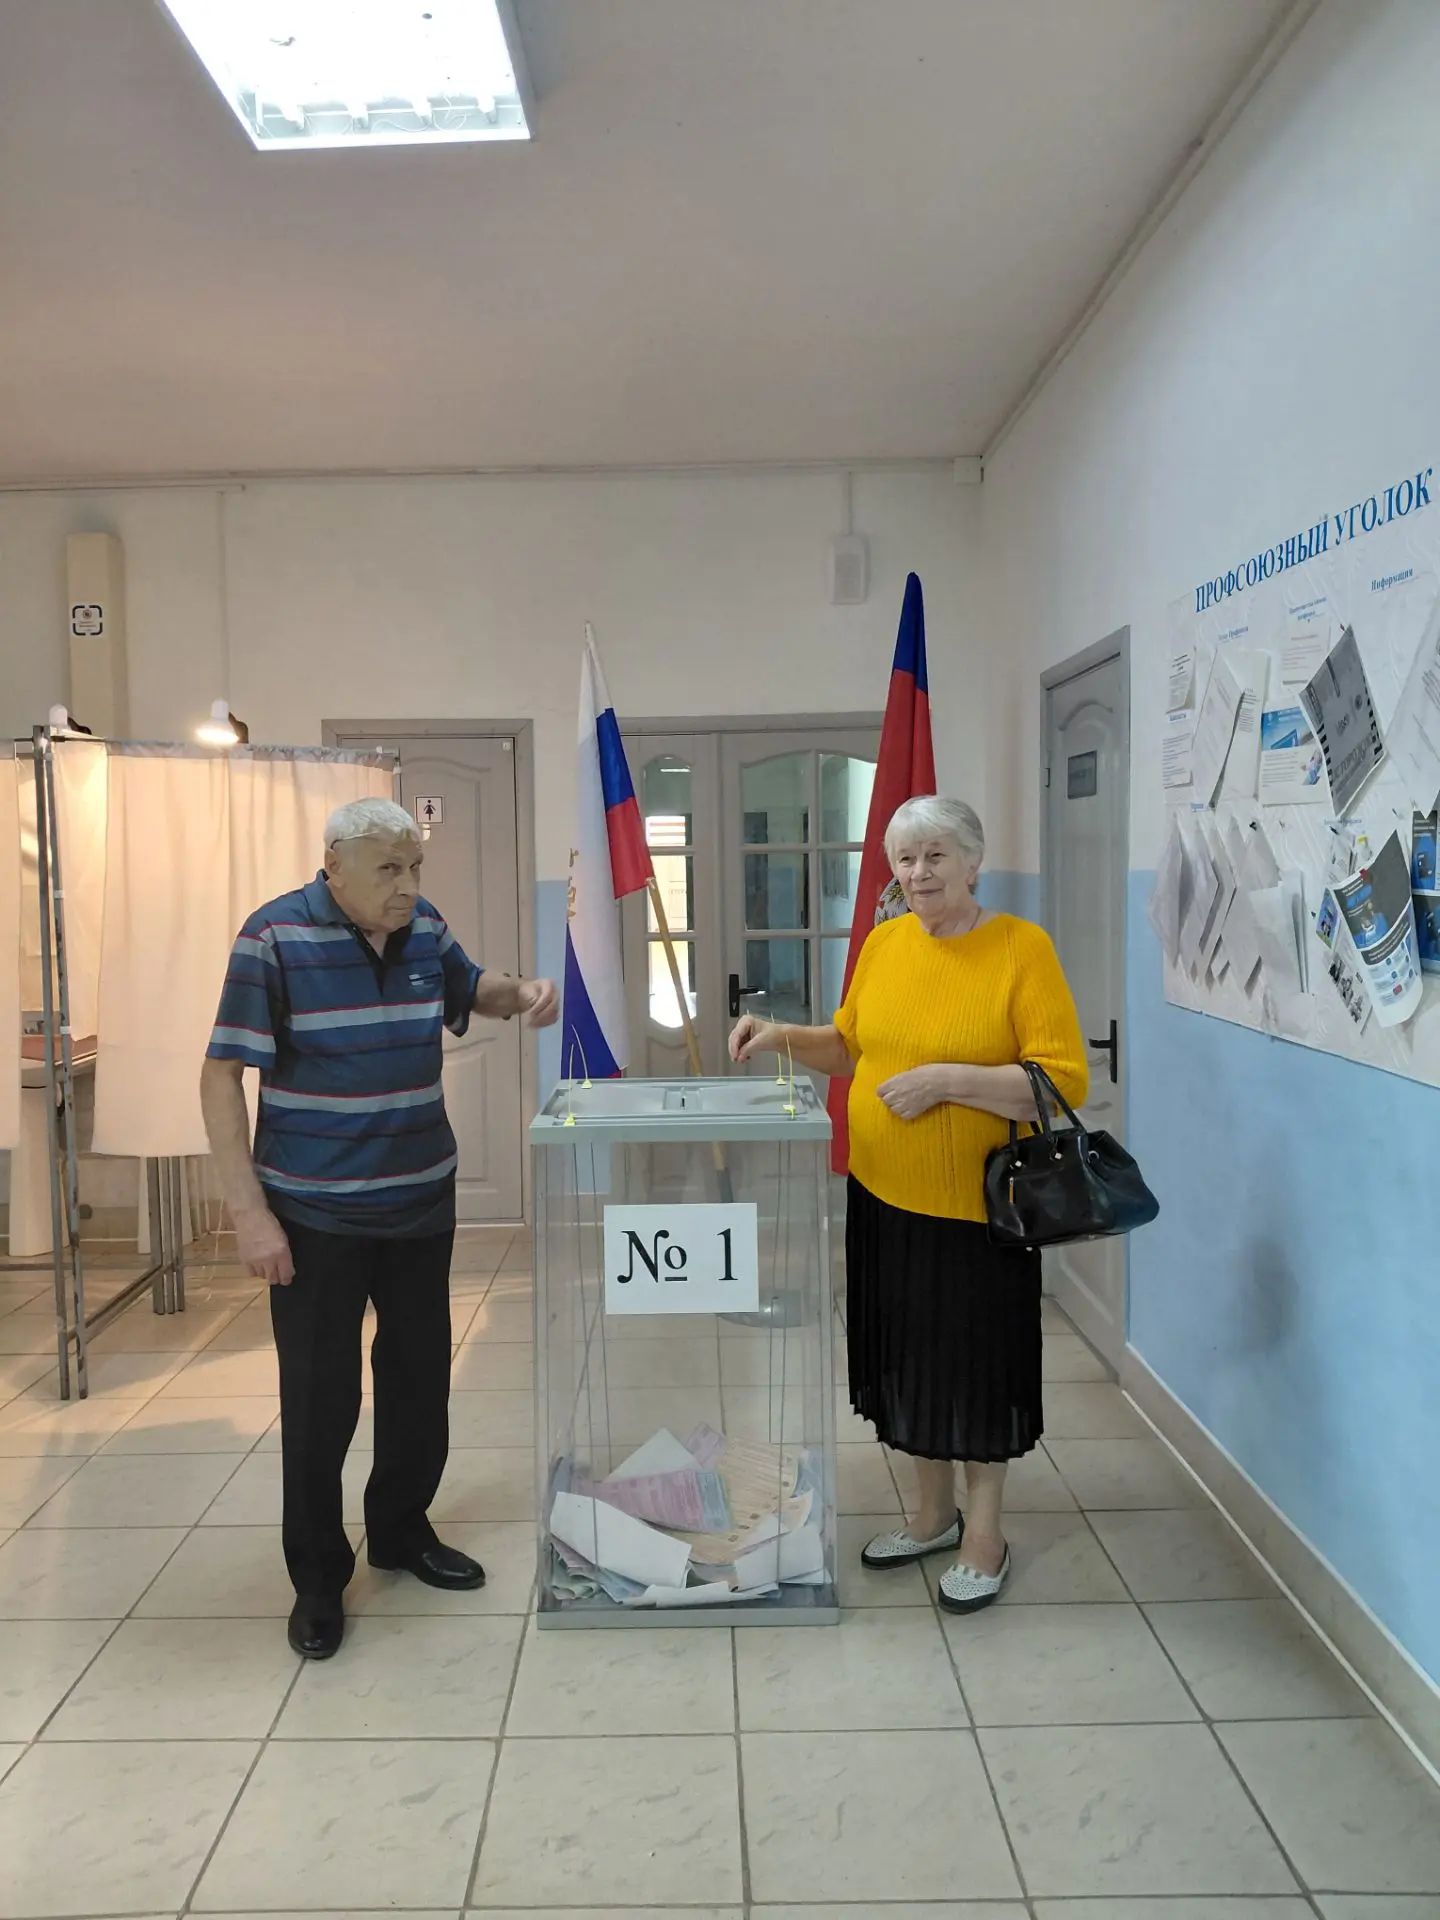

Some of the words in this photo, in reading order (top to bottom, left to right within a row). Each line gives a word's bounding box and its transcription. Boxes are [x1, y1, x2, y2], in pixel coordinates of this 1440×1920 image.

[1195, 514, 1329, 613] ПРОФСОЮЗНЫЙ
[1334, 467, 1433, 545] УГОЛОК
[716, 1227, 739, 1281] 1
